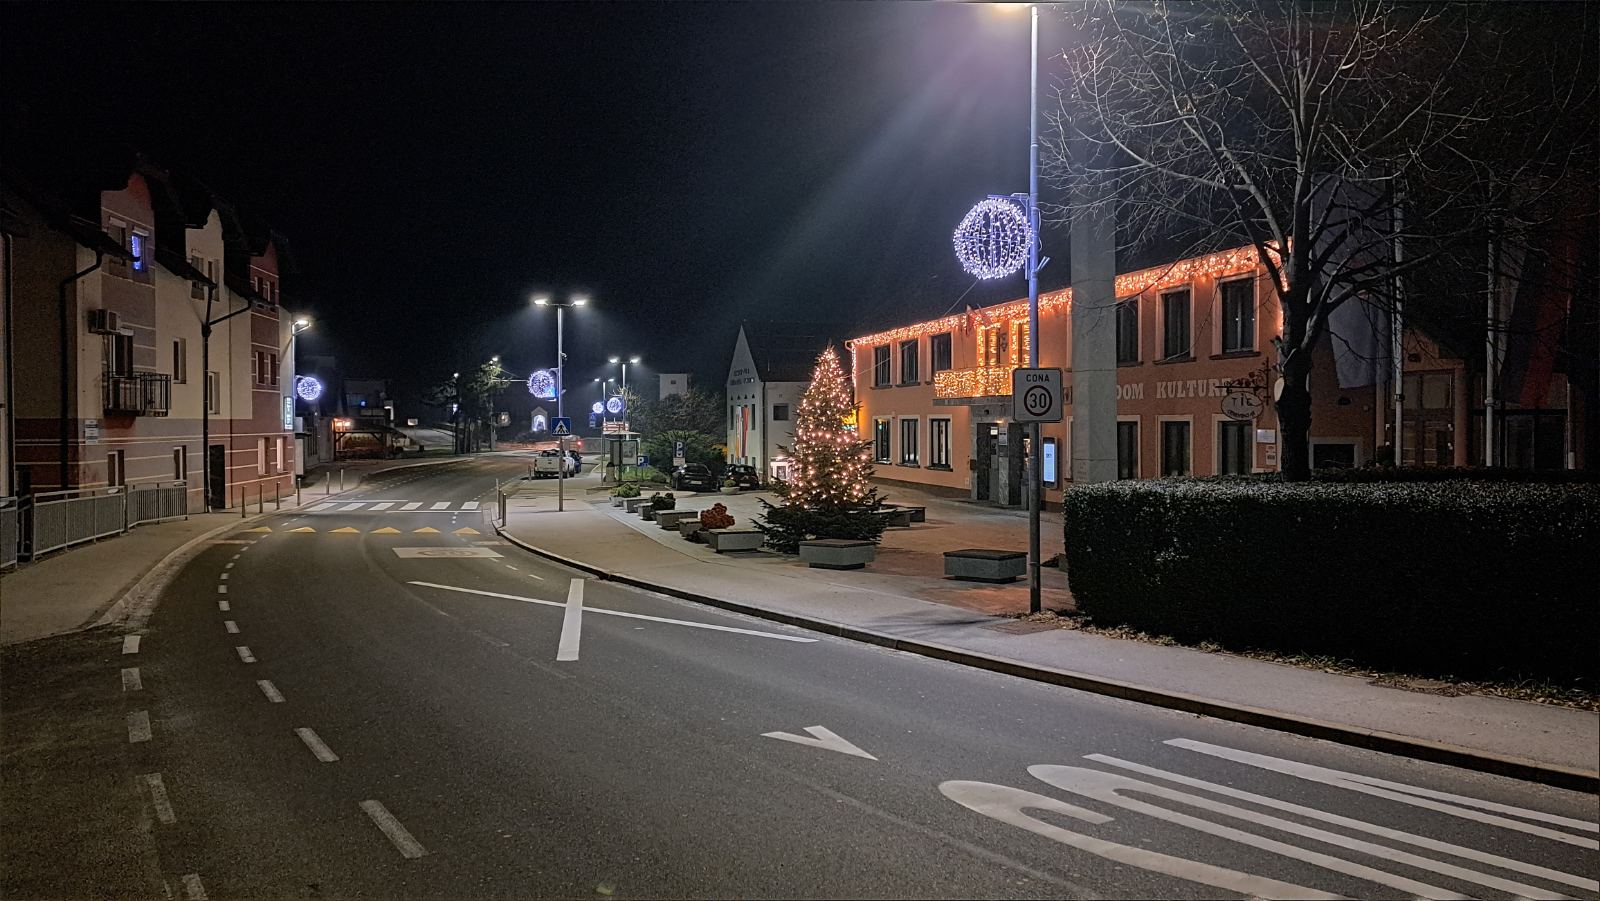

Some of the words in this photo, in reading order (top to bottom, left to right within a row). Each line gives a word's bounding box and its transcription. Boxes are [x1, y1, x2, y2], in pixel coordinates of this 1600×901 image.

[1026, 373, 1050, 382] CONA
[1029, 392, 1047, 409] 30
[637, 456, 645, 466] P
